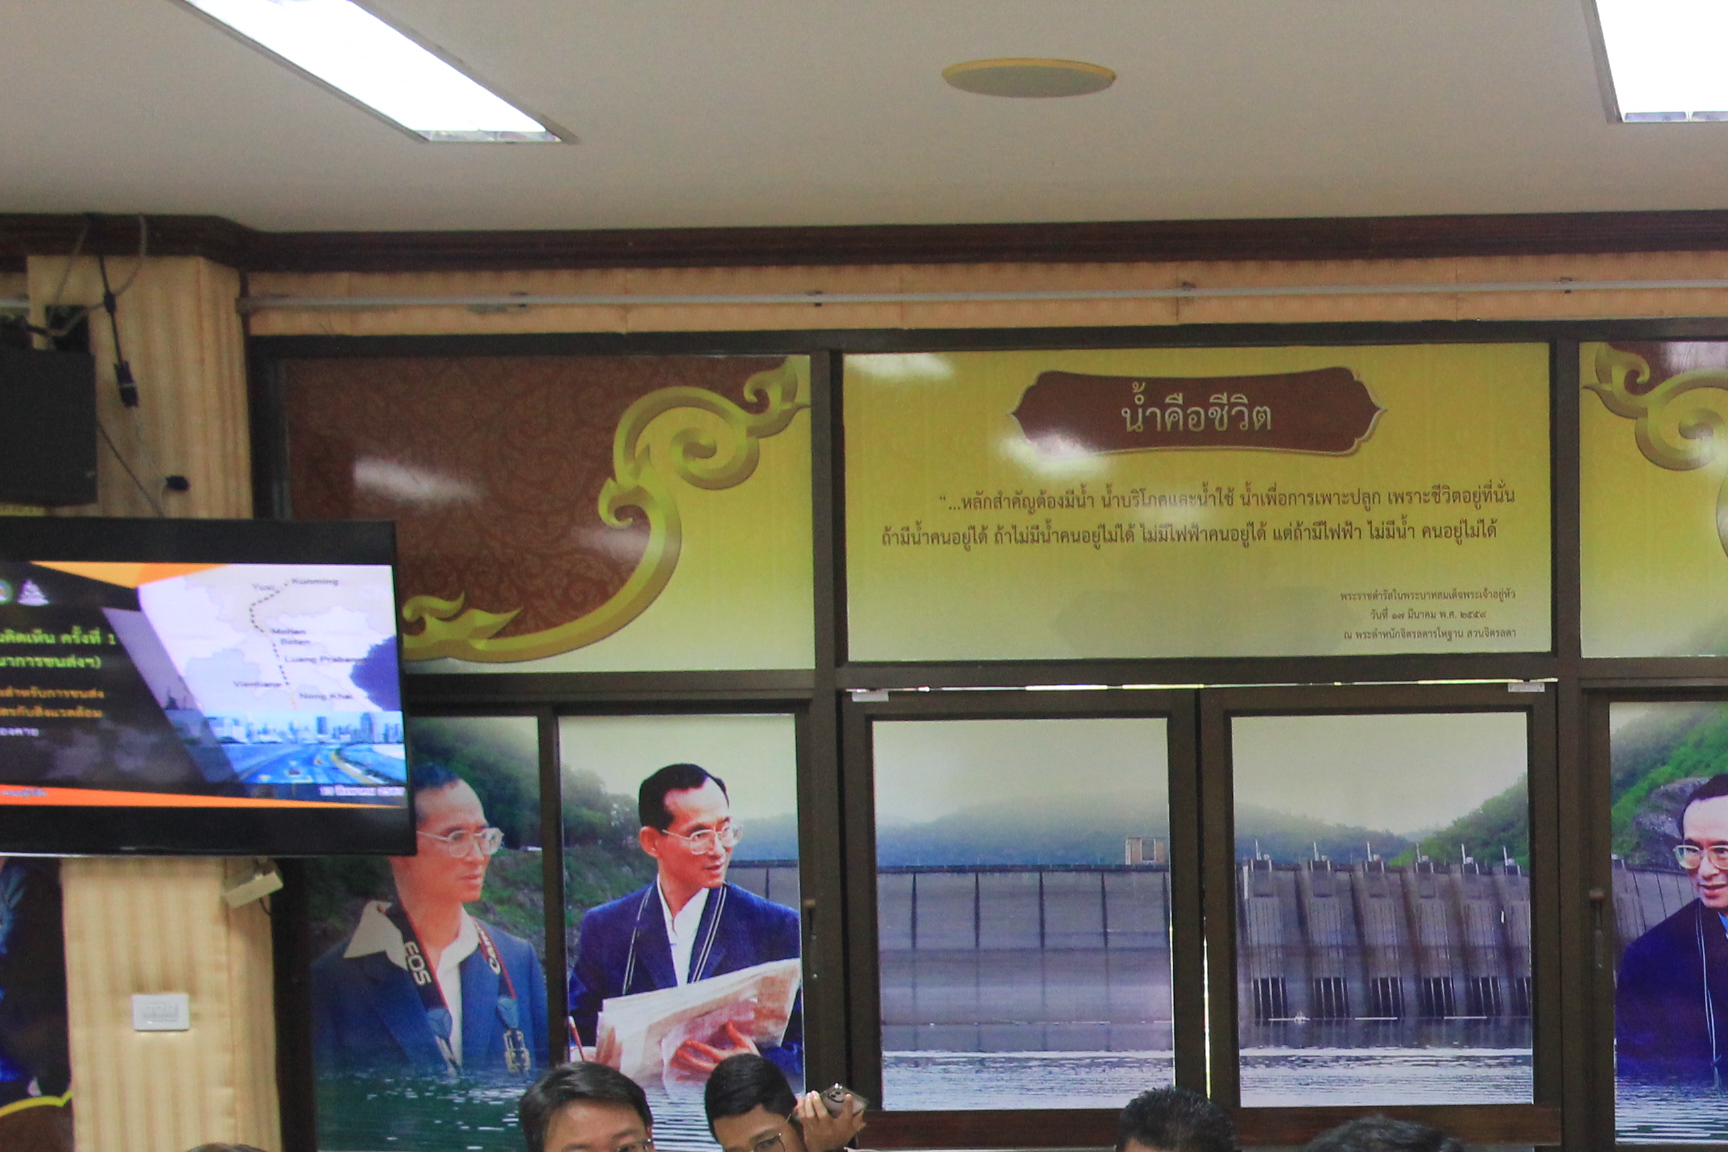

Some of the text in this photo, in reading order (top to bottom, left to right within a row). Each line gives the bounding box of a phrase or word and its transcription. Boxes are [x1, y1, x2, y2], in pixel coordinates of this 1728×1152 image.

[1121, 381, 1272, 432] น้ำคือชีวิต
[1240, 480, 1381, 511] น้ำเพื่อการเพาะปลูก
[1388, 479, 1515, 510] เพราะชีวิตอยู่ที่นั่น
[882, 514, 1498, 551] ถ้ามีน้ำคนอยู่ได้ ถ้าไม่มีน้ำคนอยู่ไม่ได้ ไม่มีไฟฟ้าคนอยู่ได้ แต่ถ้ามีไฟฟ้า ไม่มีน้ำ คนอยู่ไม่ได้
[1370, 606, 1389, 620] วันที่
[1407, 608, 1437, 620] มีนาคม
